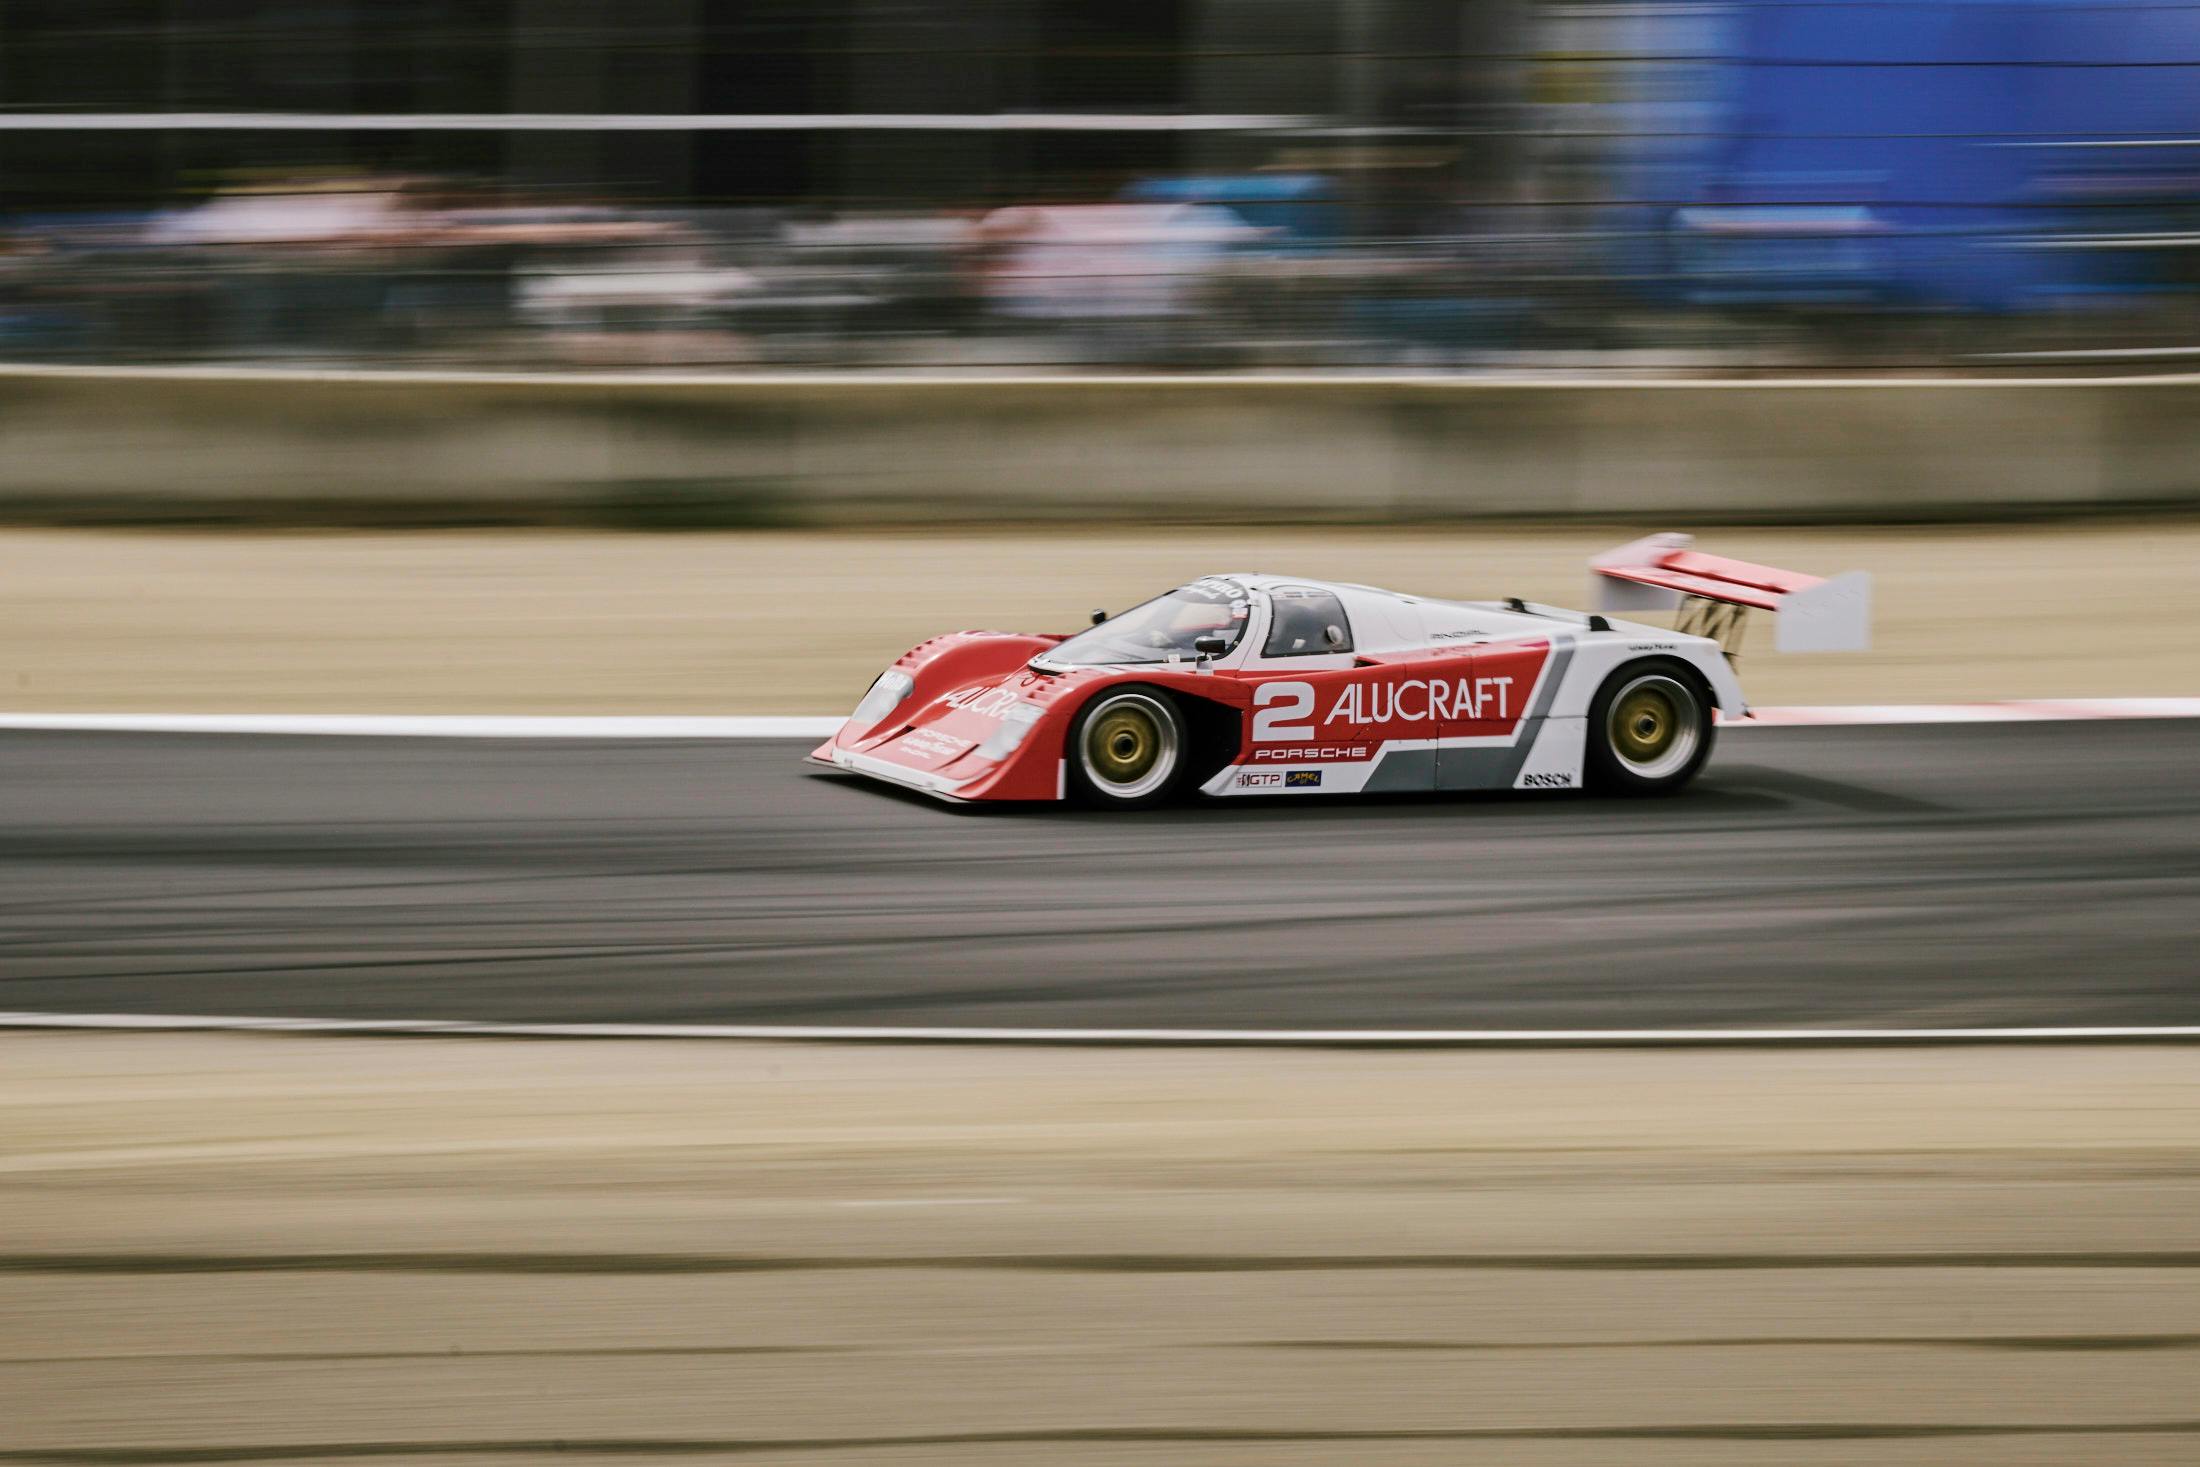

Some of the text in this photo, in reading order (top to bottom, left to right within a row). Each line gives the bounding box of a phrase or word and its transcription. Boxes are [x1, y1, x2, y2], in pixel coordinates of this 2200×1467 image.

[1324, 676, 1514, 726] ALUCRAFT
[1252, 681, 1315, 741] 2
[1255, 747, 1367, 760] PORSCHE
[1250, 774, 1281, 785] GTP
[1286, 772, 1320, 783] CAMEL
[1524, 774, 1572, 786] BOSCH
